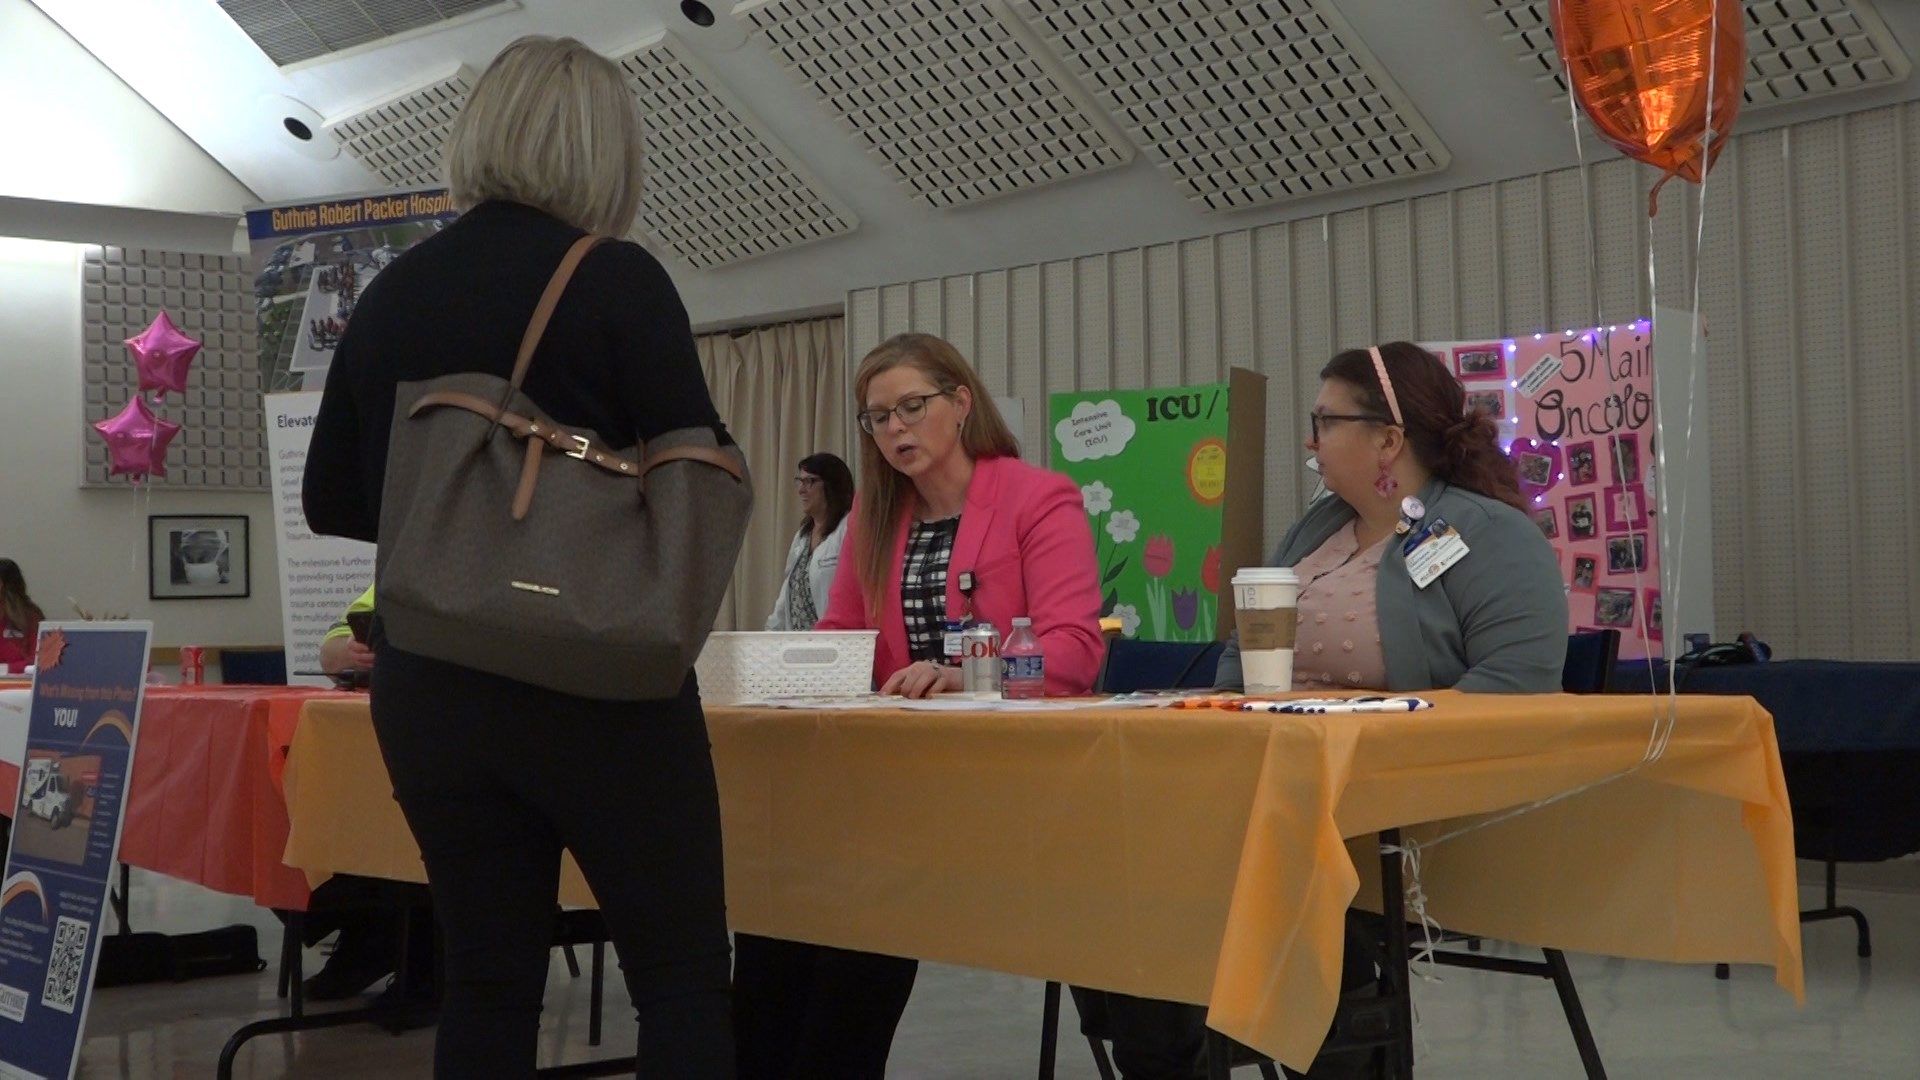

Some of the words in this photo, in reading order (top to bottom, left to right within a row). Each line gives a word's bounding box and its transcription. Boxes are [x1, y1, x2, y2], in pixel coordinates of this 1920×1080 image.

[273, 209, 317, 232] Guthrie
[320, 204, 361, 226] Robert
[364, 198, 408, 221] Packer
[1560, 333, 1586, 383] 5
[53, 707, 79, 728] YOU!
